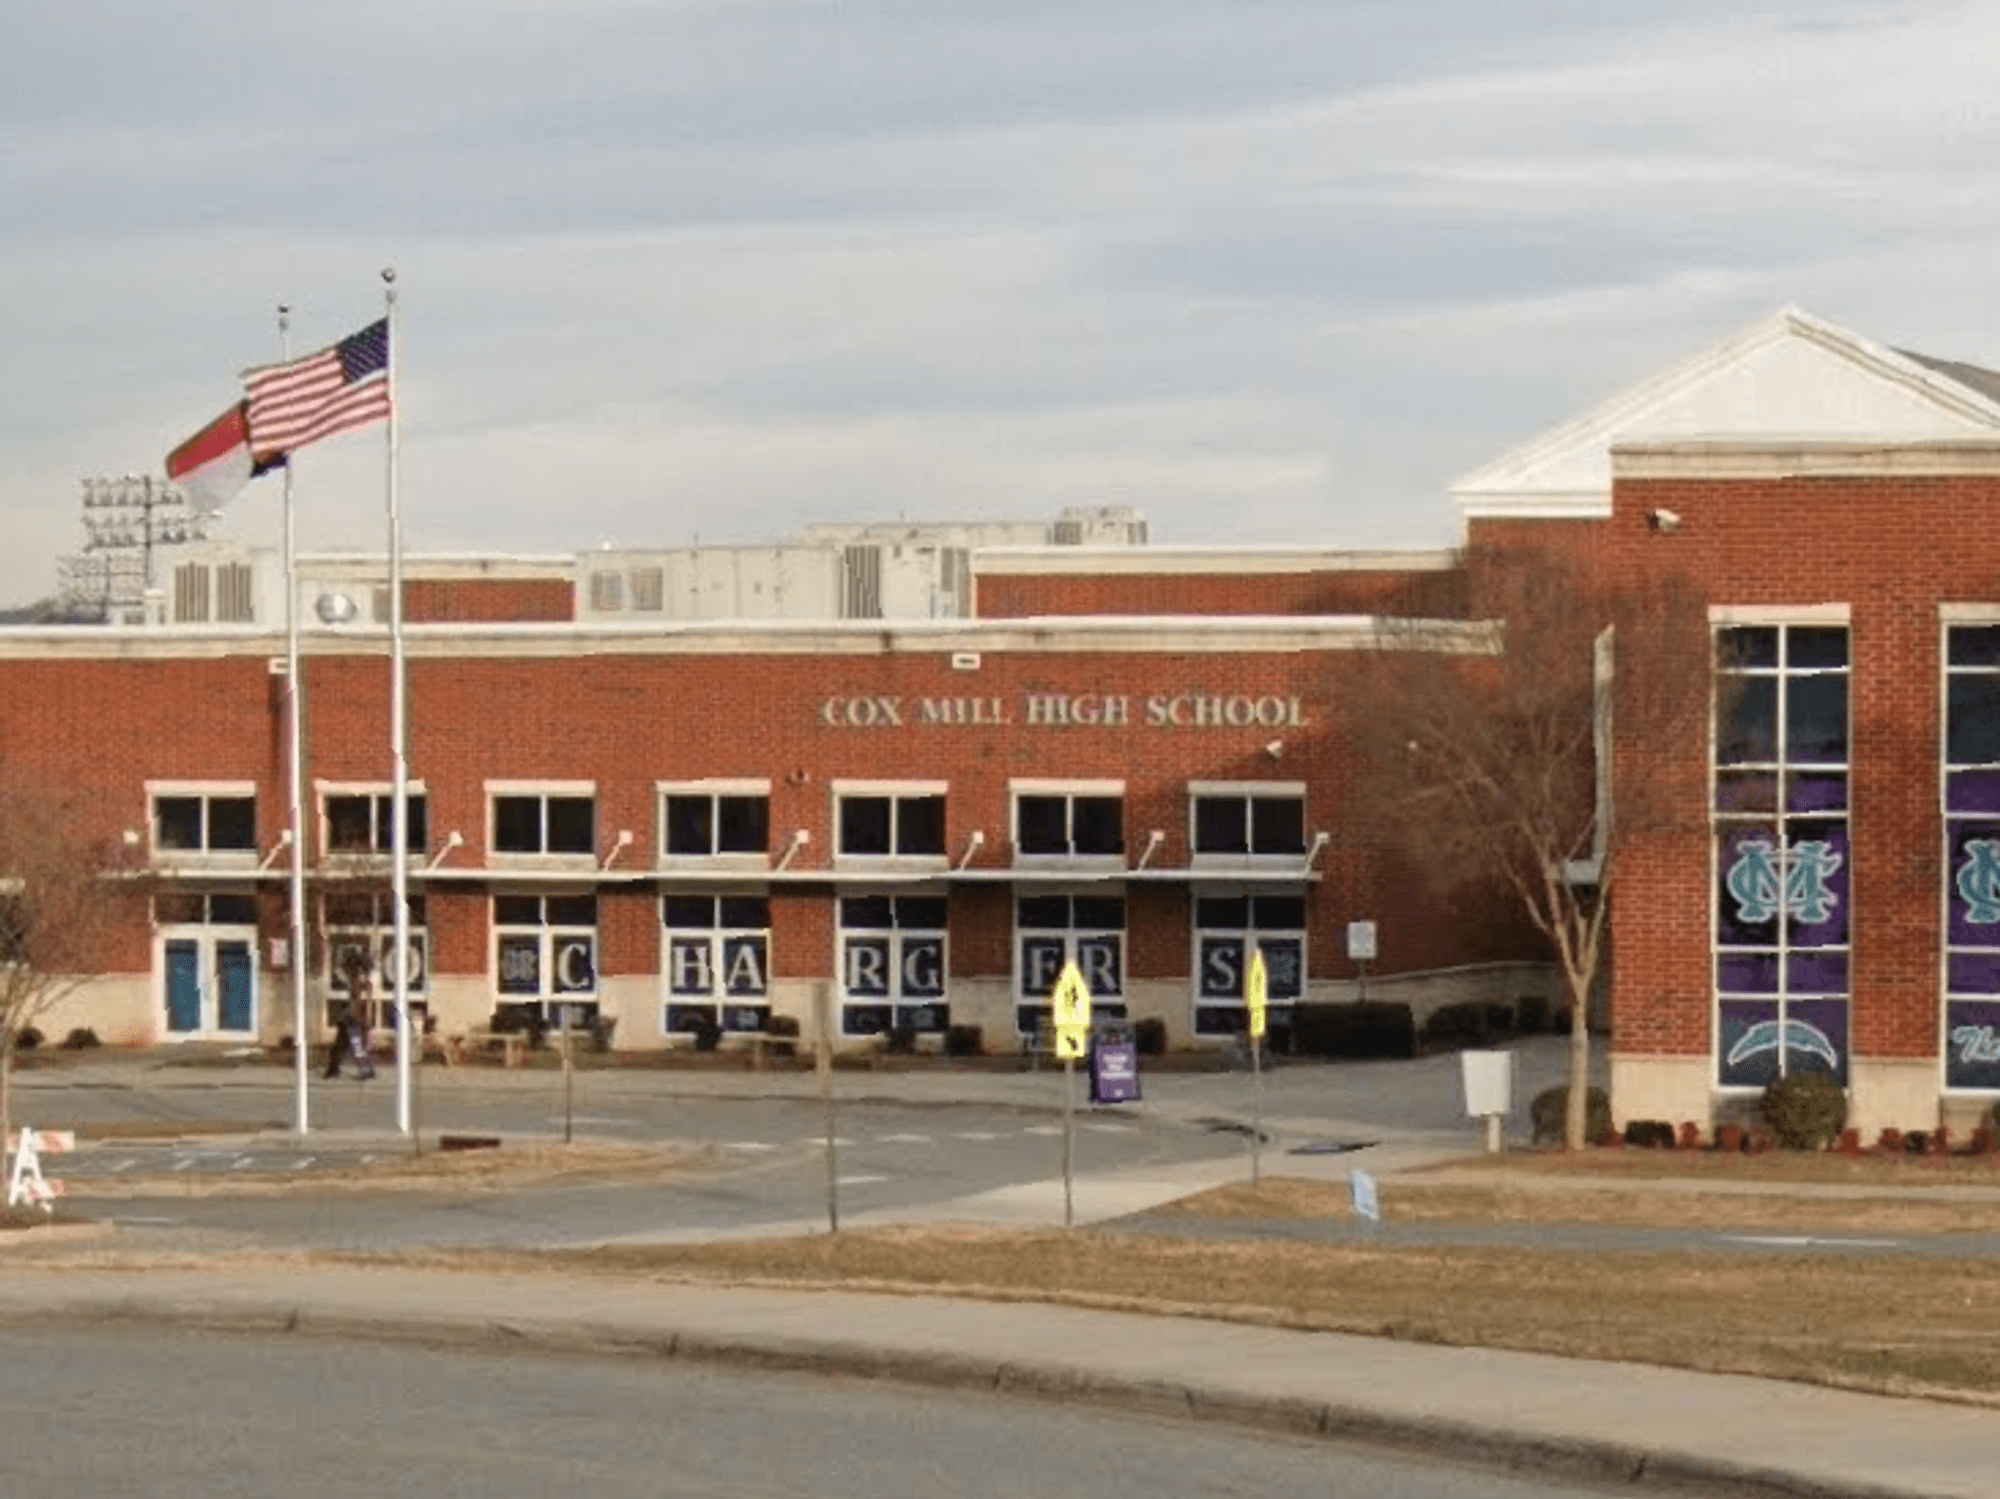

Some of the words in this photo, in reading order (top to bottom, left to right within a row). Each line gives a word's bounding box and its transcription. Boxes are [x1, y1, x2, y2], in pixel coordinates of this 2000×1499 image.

[822, 696, 903, 727] COX
[920, 697, 1011, 725] MILL
[1027, 694, 1130, 726] HIGH
[1146, 695, 1311, 728] SCHOOL
